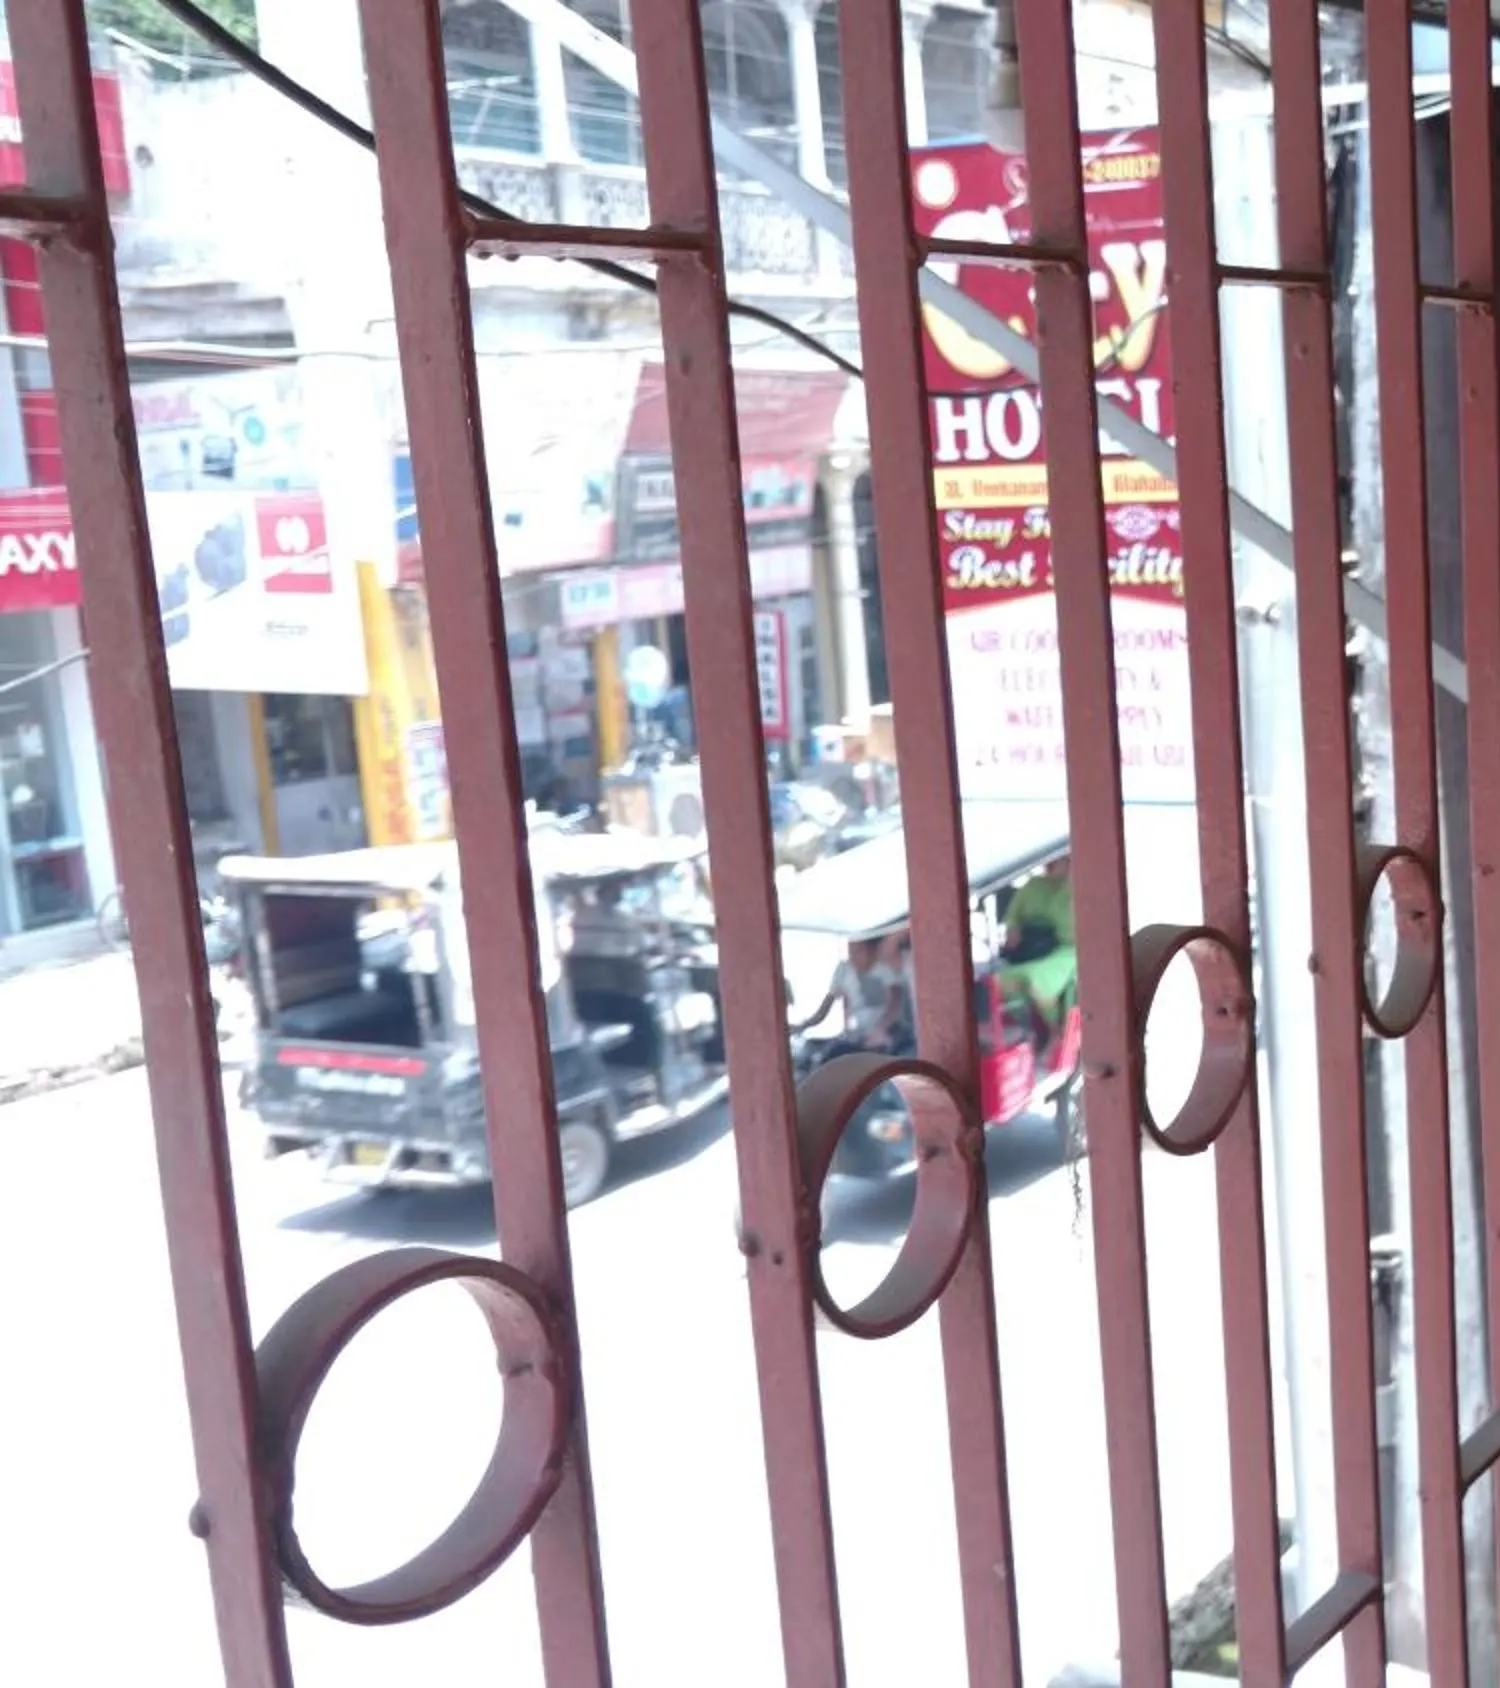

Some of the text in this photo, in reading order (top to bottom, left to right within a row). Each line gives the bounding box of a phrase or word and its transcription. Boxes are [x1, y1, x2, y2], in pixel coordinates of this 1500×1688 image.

[933, 377, 1176, 463] HOL
[943, 510, 1015, 549] Stay
[946, 545, 1036, 588] Best
